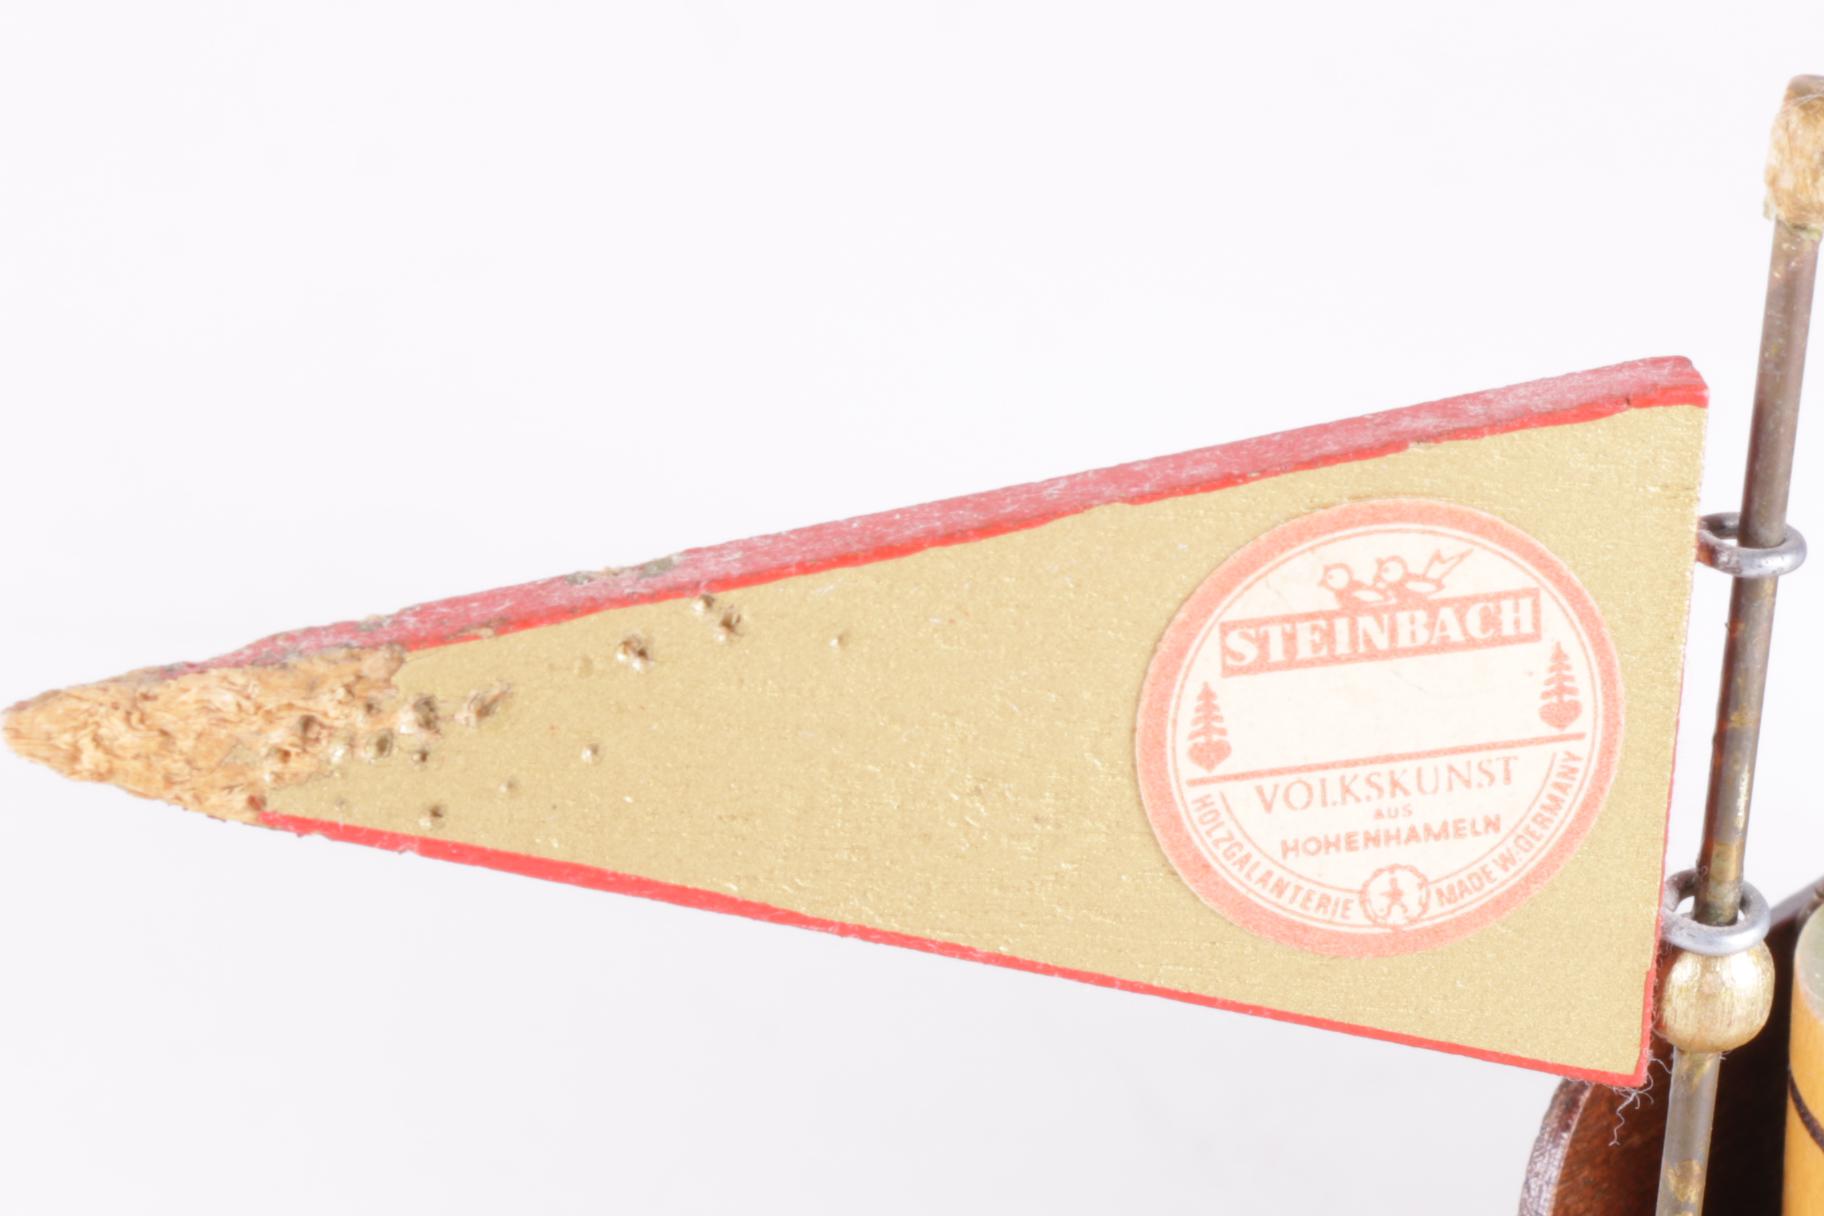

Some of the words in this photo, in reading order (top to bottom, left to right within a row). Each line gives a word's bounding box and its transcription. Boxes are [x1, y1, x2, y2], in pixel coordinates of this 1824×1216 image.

[1224, 596, 1536, 667] STEINBACH
[1255, 754, 1519, 815] VOLKSKUNST
[1373, 803, 1413, 821] AUS
[1191, 793, 1355, 920] HOLZGALANTERIE
[1435, 863, 1499, 907] MADE
[1280, 813, 1501, 861] HOHENHAMELN
